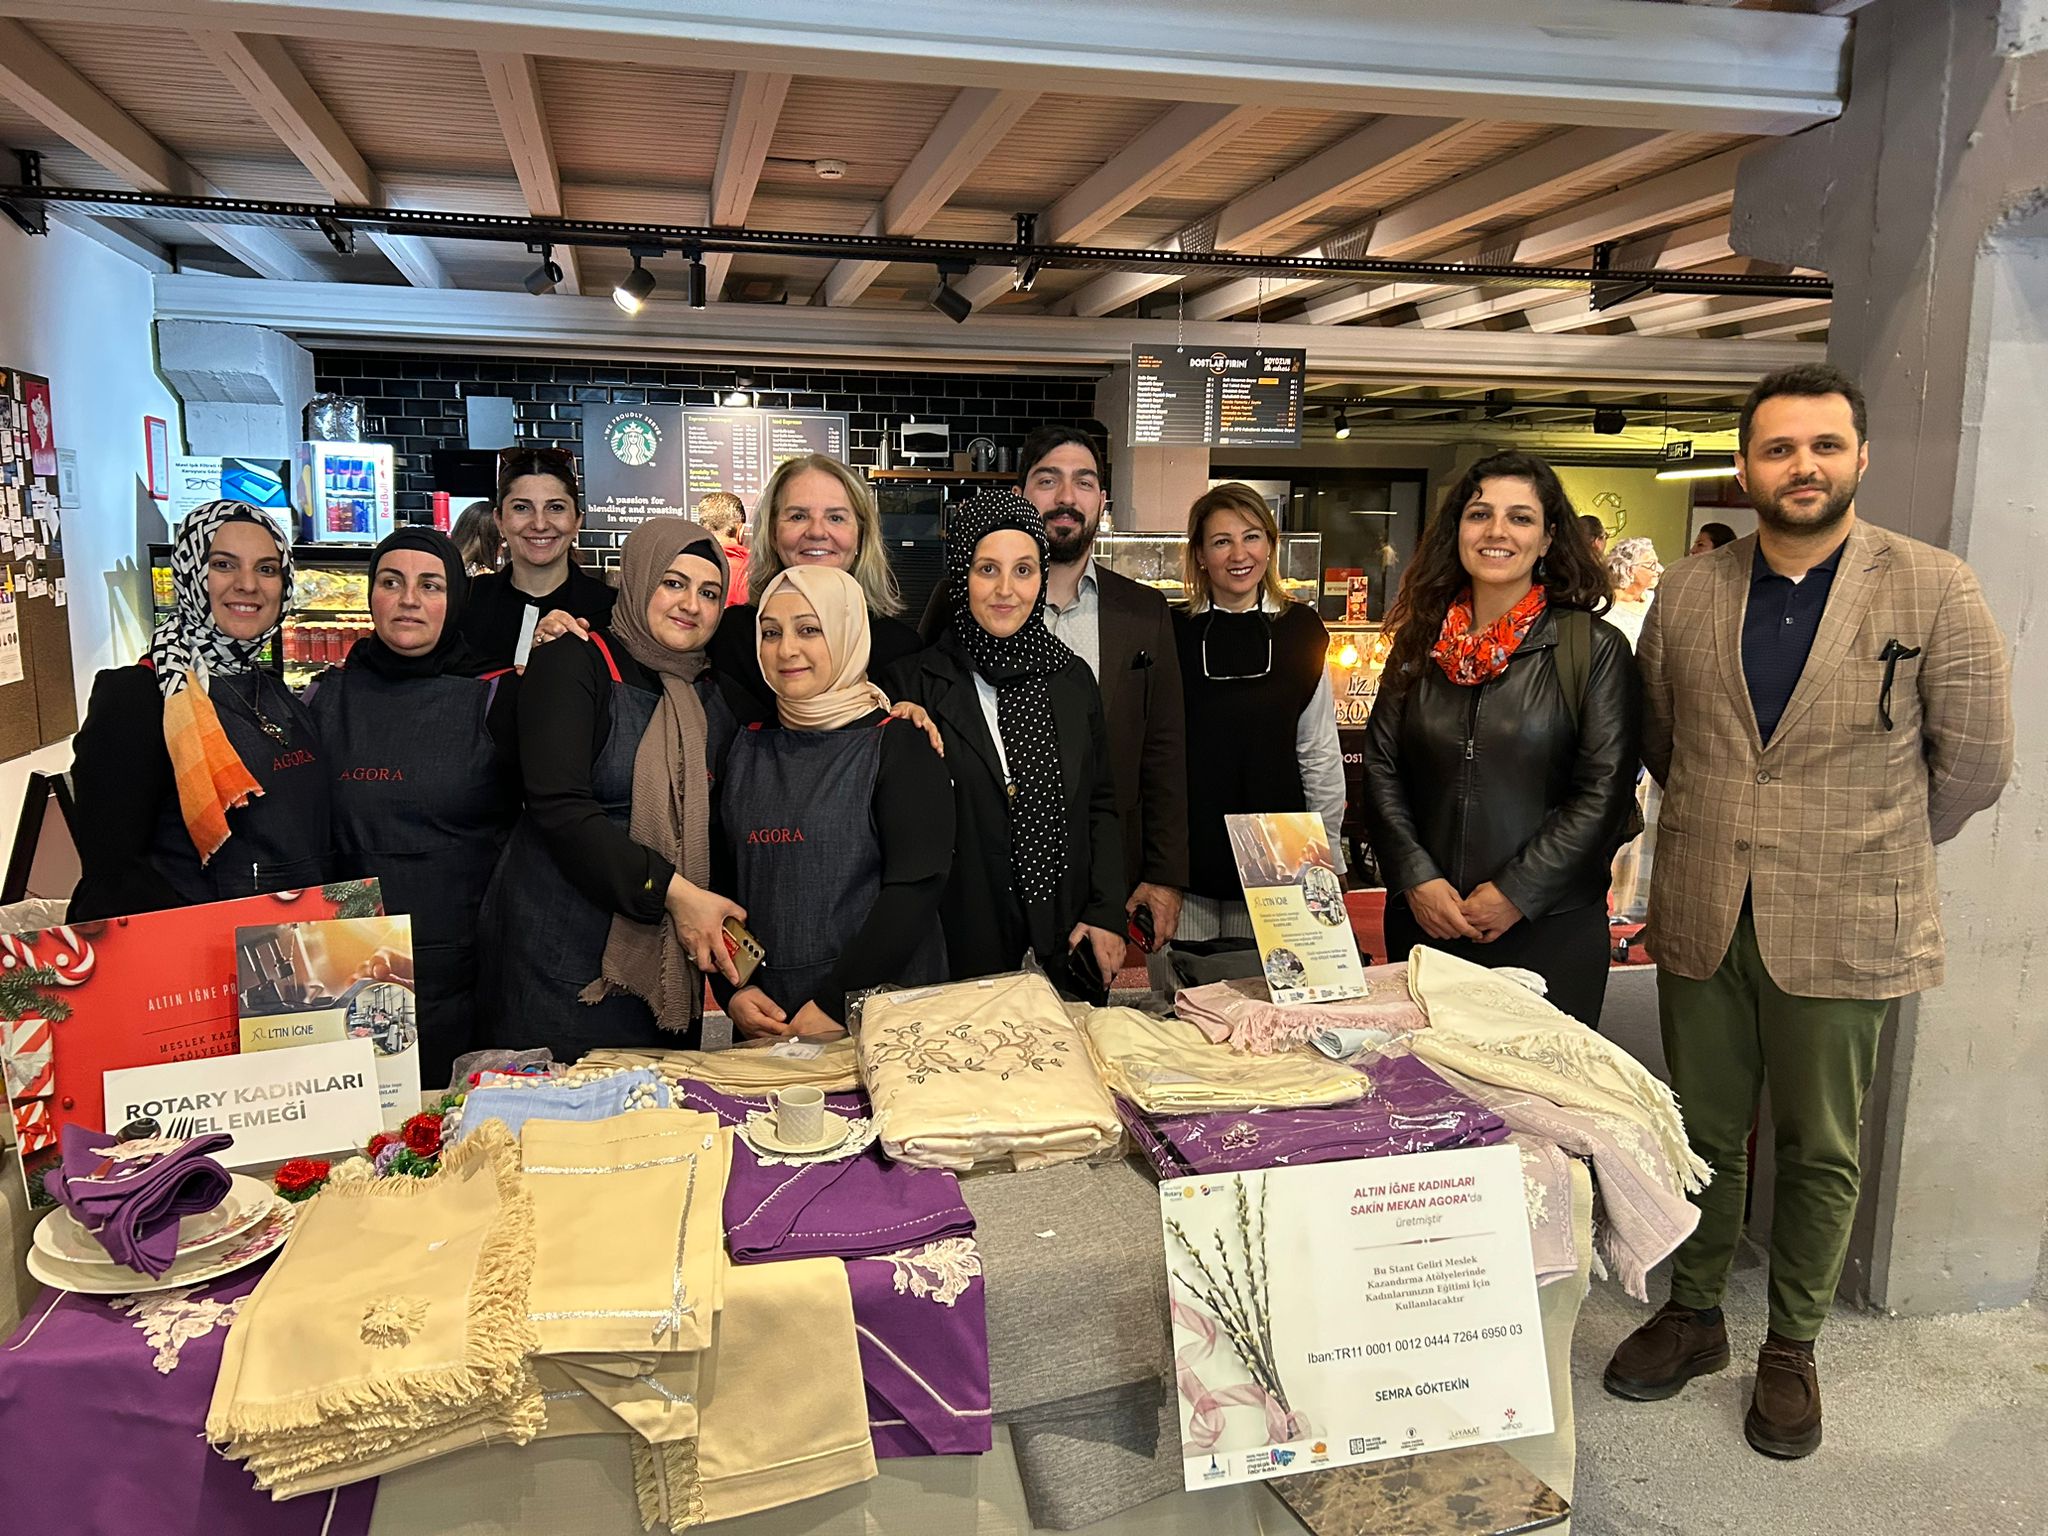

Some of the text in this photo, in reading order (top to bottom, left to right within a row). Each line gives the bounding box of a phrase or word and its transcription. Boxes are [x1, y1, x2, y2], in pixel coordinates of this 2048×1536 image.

[1190, 358, 1224, 368] DOSTLAR
[604, 412, 662, 435] WE PROUDLY SERVE
[379, 483, 390, 518] Red Bull
[588, 505, 626, 514] blending
[647, 507, 683, 516] roasting
[616, 497, 648, 505] passion
[607, 514, 616, 522] in
[273, 750, 315, 771] AGORA
[339, 767, 403, 781] AGORA
[747, 827, 805, 844] AGORA
[148, 993, 183, 1011] ALTIN
[160, 1036, 206, 1053] MESLEK
[126, 1073, 364, 1120] ROTARY KADINLARI
[194, 1101, 306, 1135] EL EMEĞİ
[1354, 1176, 1475, 1198] ALTIN İĞNE KADINLARI
[1350, 1193, 1482, 1216] SAKİN MEKAN AGORA'da
[1396, 1214, 1443, 1228] üretmiştir
[1373, 1255, 1478, 1276] Bu Stant Geliri Meslek
[1367, 1267, 1486, 1290] Kazandırma Atölyelerinde
[1365, 1279, 1491, 1302] Kadınlarımızın Eğitimi İçin
[1395, 1295, 1464, 1311] Kullanılacaktır
[1307, 1324, 1523, 1364] Iban:TR11 0001 0012 0444 7264 6950 03
[1375, 1377, 1470, 1402] SEMRA GÖKTEKİN
